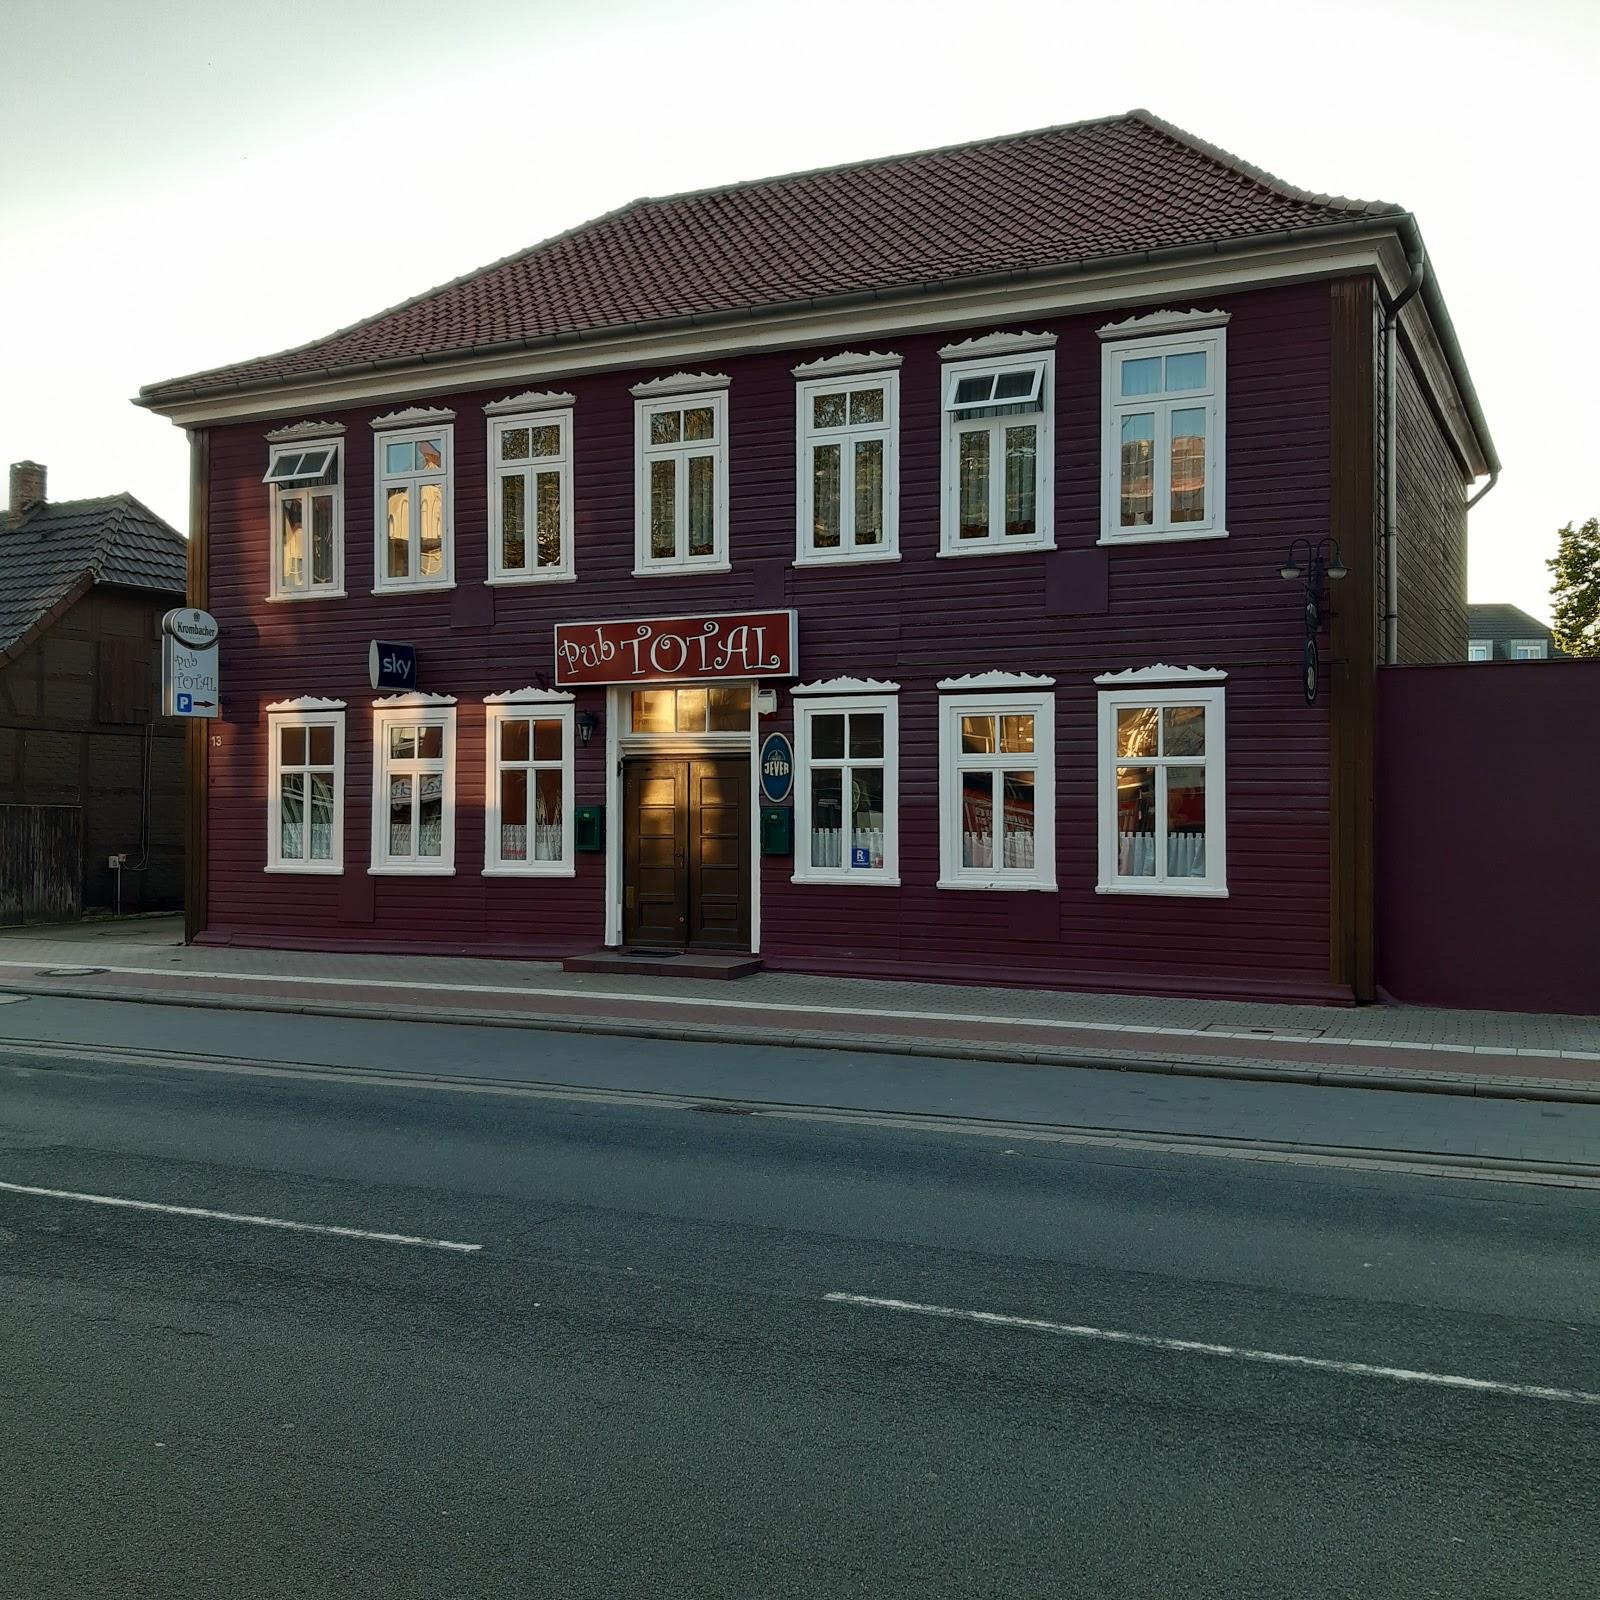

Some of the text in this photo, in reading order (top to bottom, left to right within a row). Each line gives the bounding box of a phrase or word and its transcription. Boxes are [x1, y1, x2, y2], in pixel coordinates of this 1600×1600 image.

[177, 621, 215, 637] Krombacher
[558, 621, 781, 675] Pub TOTAL
[175, 651, 198, 670] Pub
[383, 653, 412, 680] sky
[175, 674, 217, 692] TOTAL
[180, 697, 189, 710] P
[211, 735, 222, 747] 13
[764, 760, 790, 777] JEVER
[856, 850, 864, 860] R
